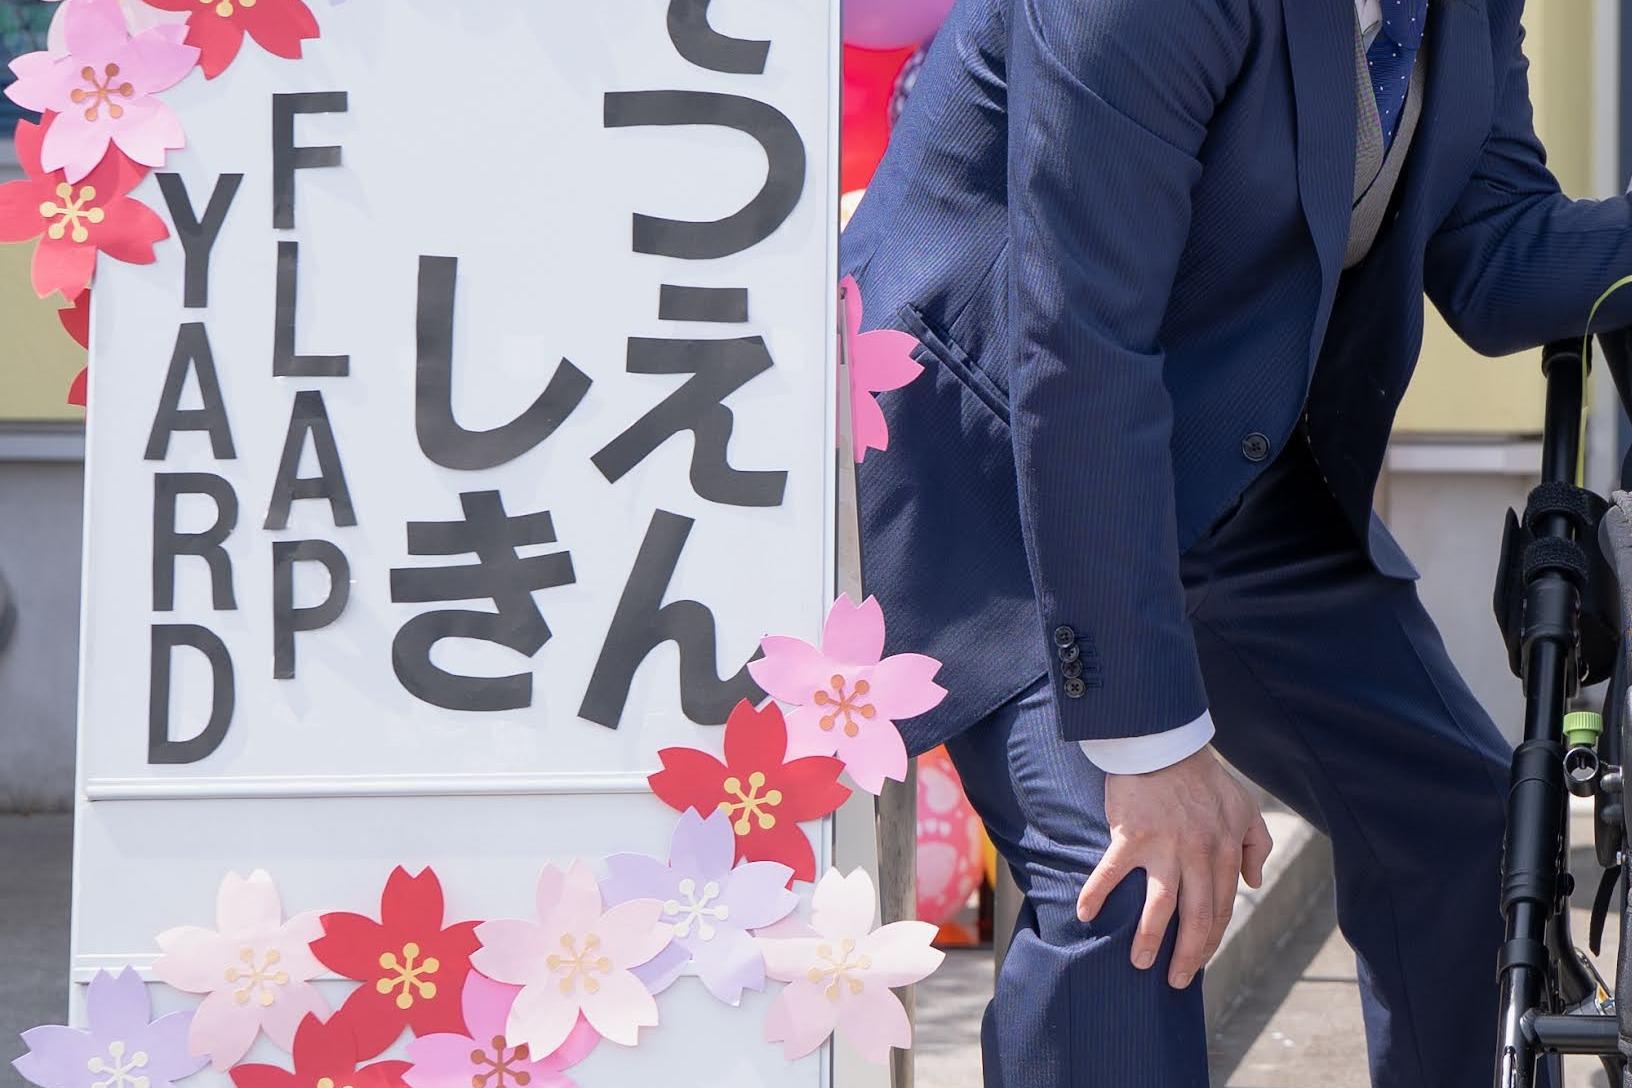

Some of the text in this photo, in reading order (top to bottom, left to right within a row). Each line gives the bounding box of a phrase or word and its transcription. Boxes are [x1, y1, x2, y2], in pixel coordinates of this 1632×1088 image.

[144, 173, 243, 764] YARD
[264, 92, 357, 679] FLAP
[390, 256, 592, 711] しき
